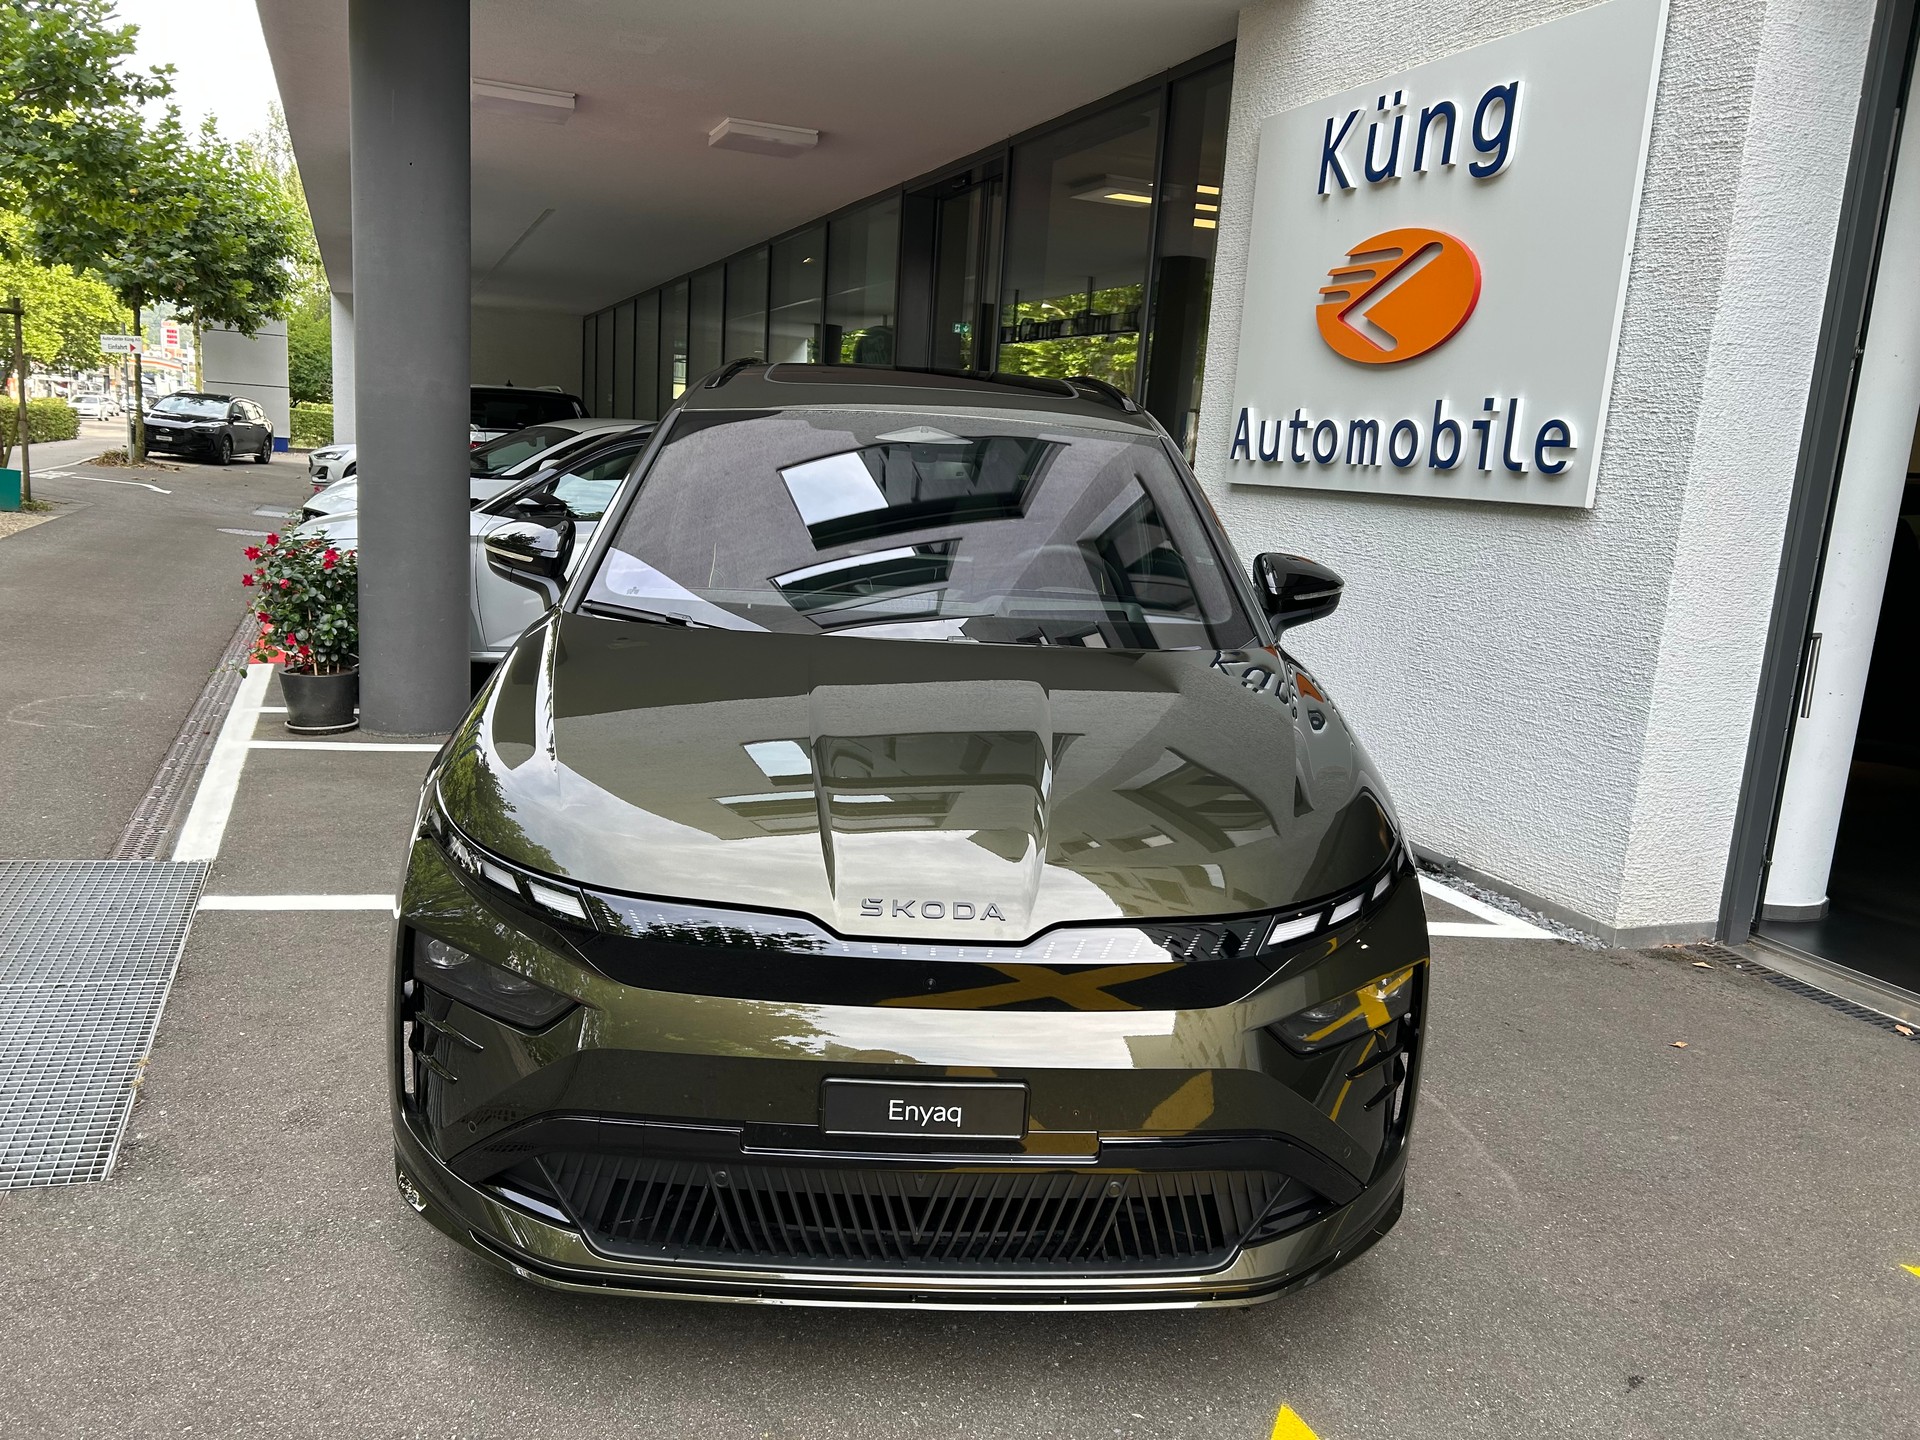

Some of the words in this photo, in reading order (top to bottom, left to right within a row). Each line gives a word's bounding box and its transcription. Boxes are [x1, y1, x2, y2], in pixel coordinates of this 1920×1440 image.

[1317, 80, 1525, 195] Küng
[1230, 397, 1578, 475] Automobile
[888, 1099, 962, 1128] Enyaq
